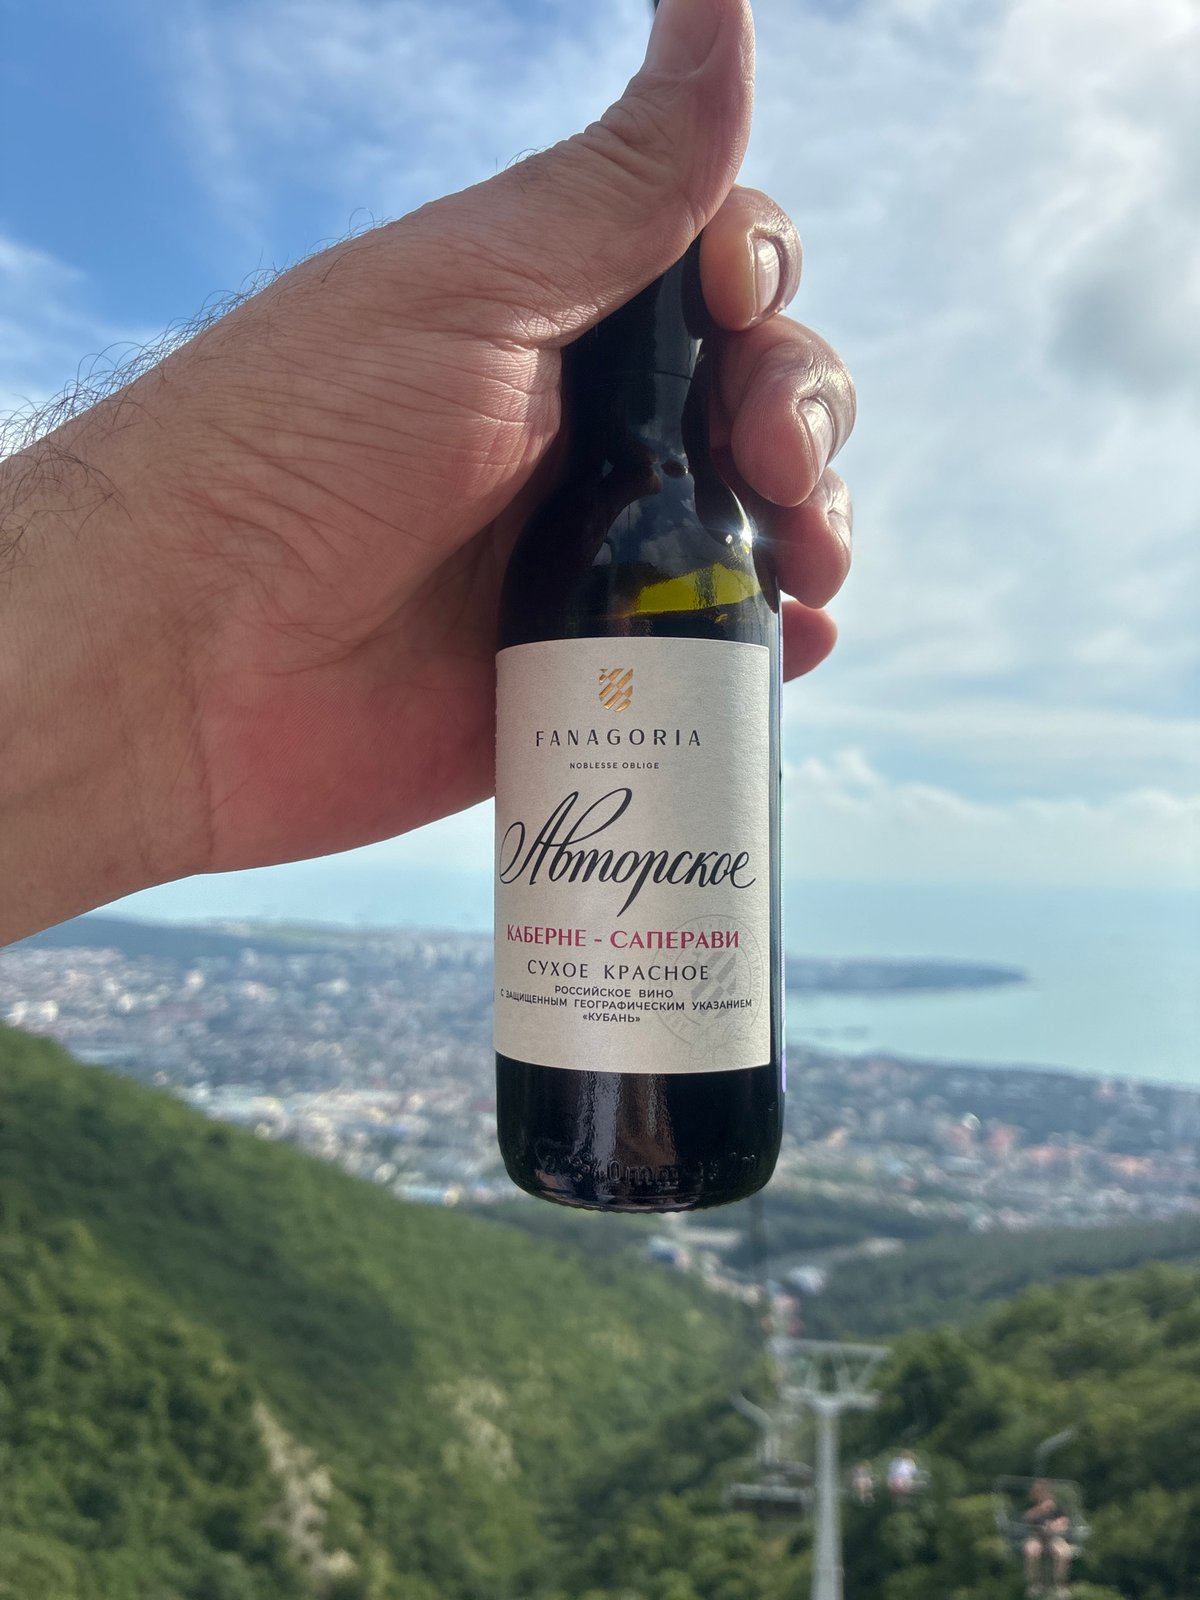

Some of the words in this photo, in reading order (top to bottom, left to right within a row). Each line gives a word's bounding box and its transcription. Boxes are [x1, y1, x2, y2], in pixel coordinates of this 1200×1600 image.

[535, 728, 701, 747] FANAGORIA
[500, 787, 756, 917] Авторское
[507, 924, 587, 947] КАБЕРНЕ
[610, 930, 739, 949] САПЕРАВИ
[527, 959, 588, 979] СУХОЕ
[604, 964, 709, 981] КРАСНОЕ
[500, 988, 505, 997] С
[506, 990, 567, 1007] ЗАЩИЩЕННЫМ
[574, 999, 685, 1011] ГЕОГРАФИЧЕСКИМ
[692, 999, 752, 1010] УКАЗАНИЕМ
[554, 985, 631, 998] РОССИЙСКОЕ
[638, 989, 674, 998] ВИНО
[582, 1012, 640, 1023] «КУБАНЬ»
